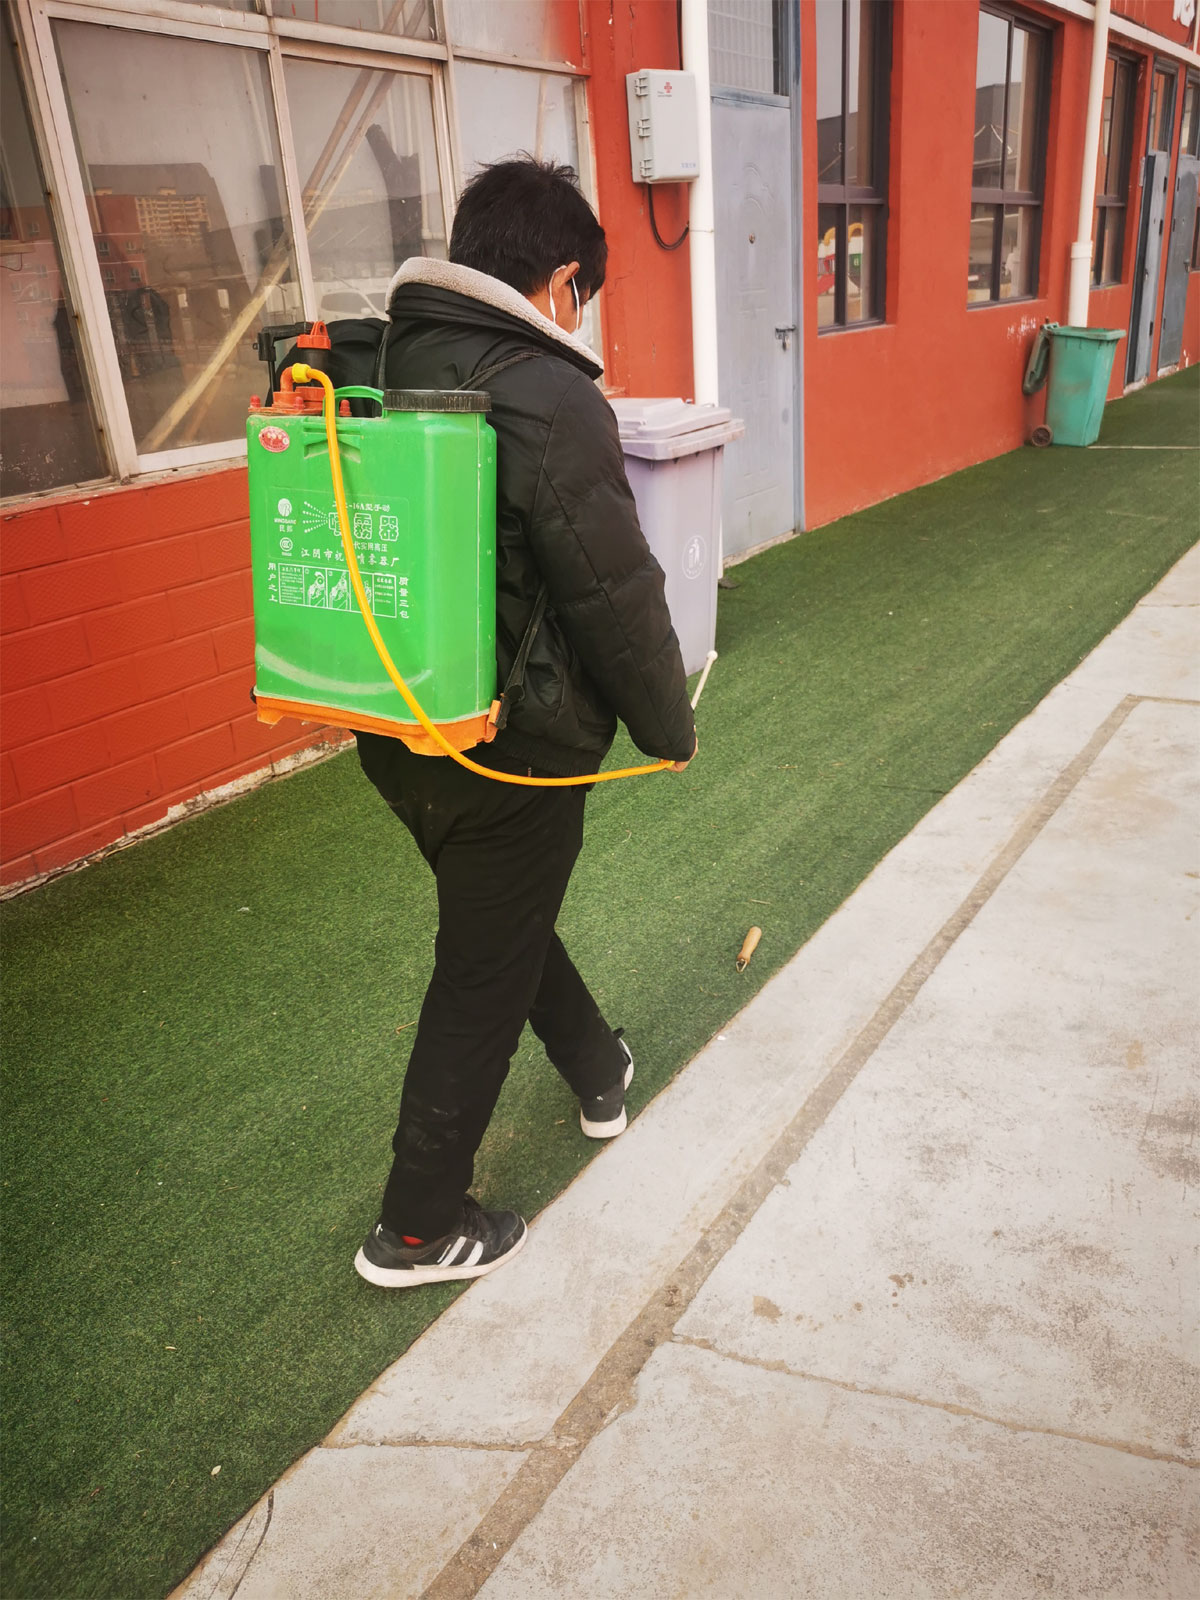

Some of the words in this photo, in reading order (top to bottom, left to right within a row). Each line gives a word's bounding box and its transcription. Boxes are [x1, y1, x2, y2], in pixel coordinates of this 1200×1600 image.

[341, 540, 388, 553] 代实用高压
[399, 576, 410, 619] 质量三包
